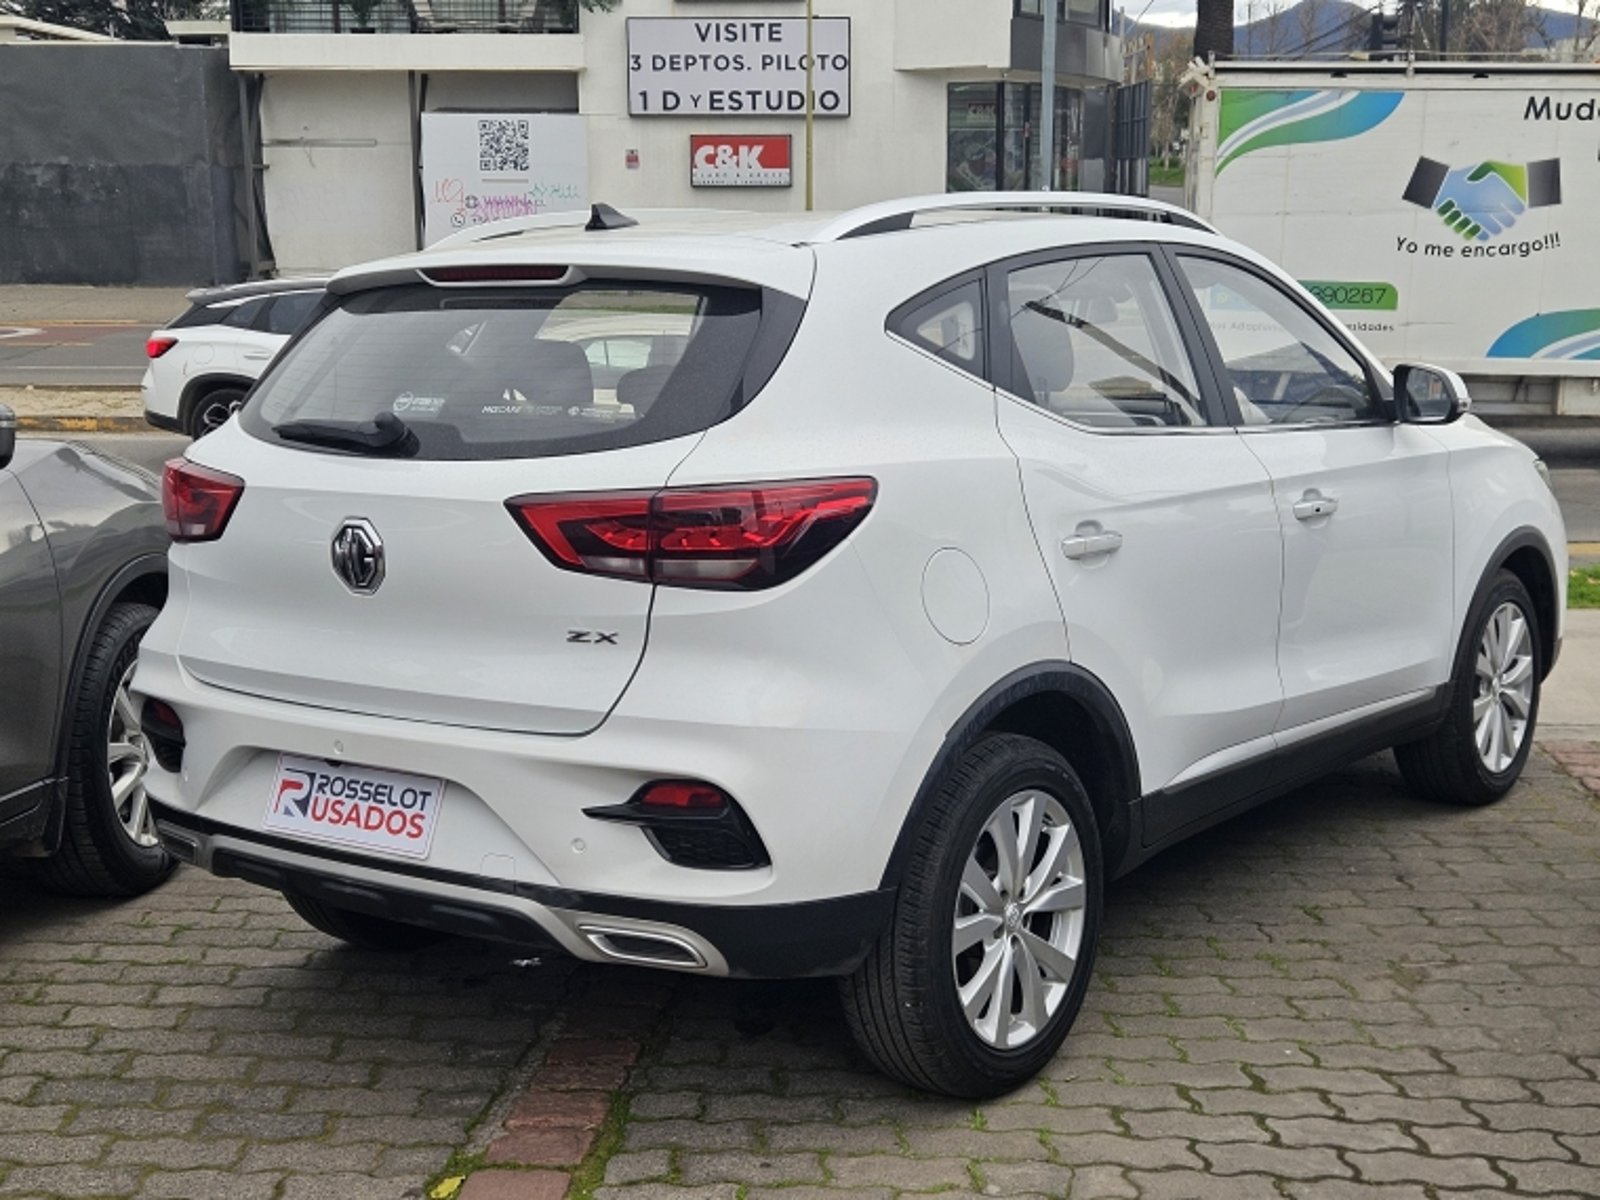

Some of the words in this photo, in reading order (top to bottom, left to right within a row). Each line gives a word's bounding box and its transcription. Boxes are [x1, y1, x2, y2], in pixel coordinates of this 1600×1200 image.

[694, 22, 782, 43] VISITE
[630, 54, 642, 72] 3
[652, 54, 752, 72] DEPTOS.
[761, 54, 848, 72] PILOTO
[639, 90, 649, 111] 1
[662, 90, 681, 111] D
[690, 94, 702, 109] Y
[709, 90, 840, 111] ESTUDIO
[1523, 96, 1600, 121] Mud
[694, 144, 765, 169] C&K
[1396, 236, 1418, 254] Yo
[1424, 244, 1454, 258] me
[1460, 231, 1561, 258] encargo!!!
[566, 629, 619, 646] ZX
[315, 774, 432, 811] ROSSELOT
[311, 796, 426, 839] USADOS
